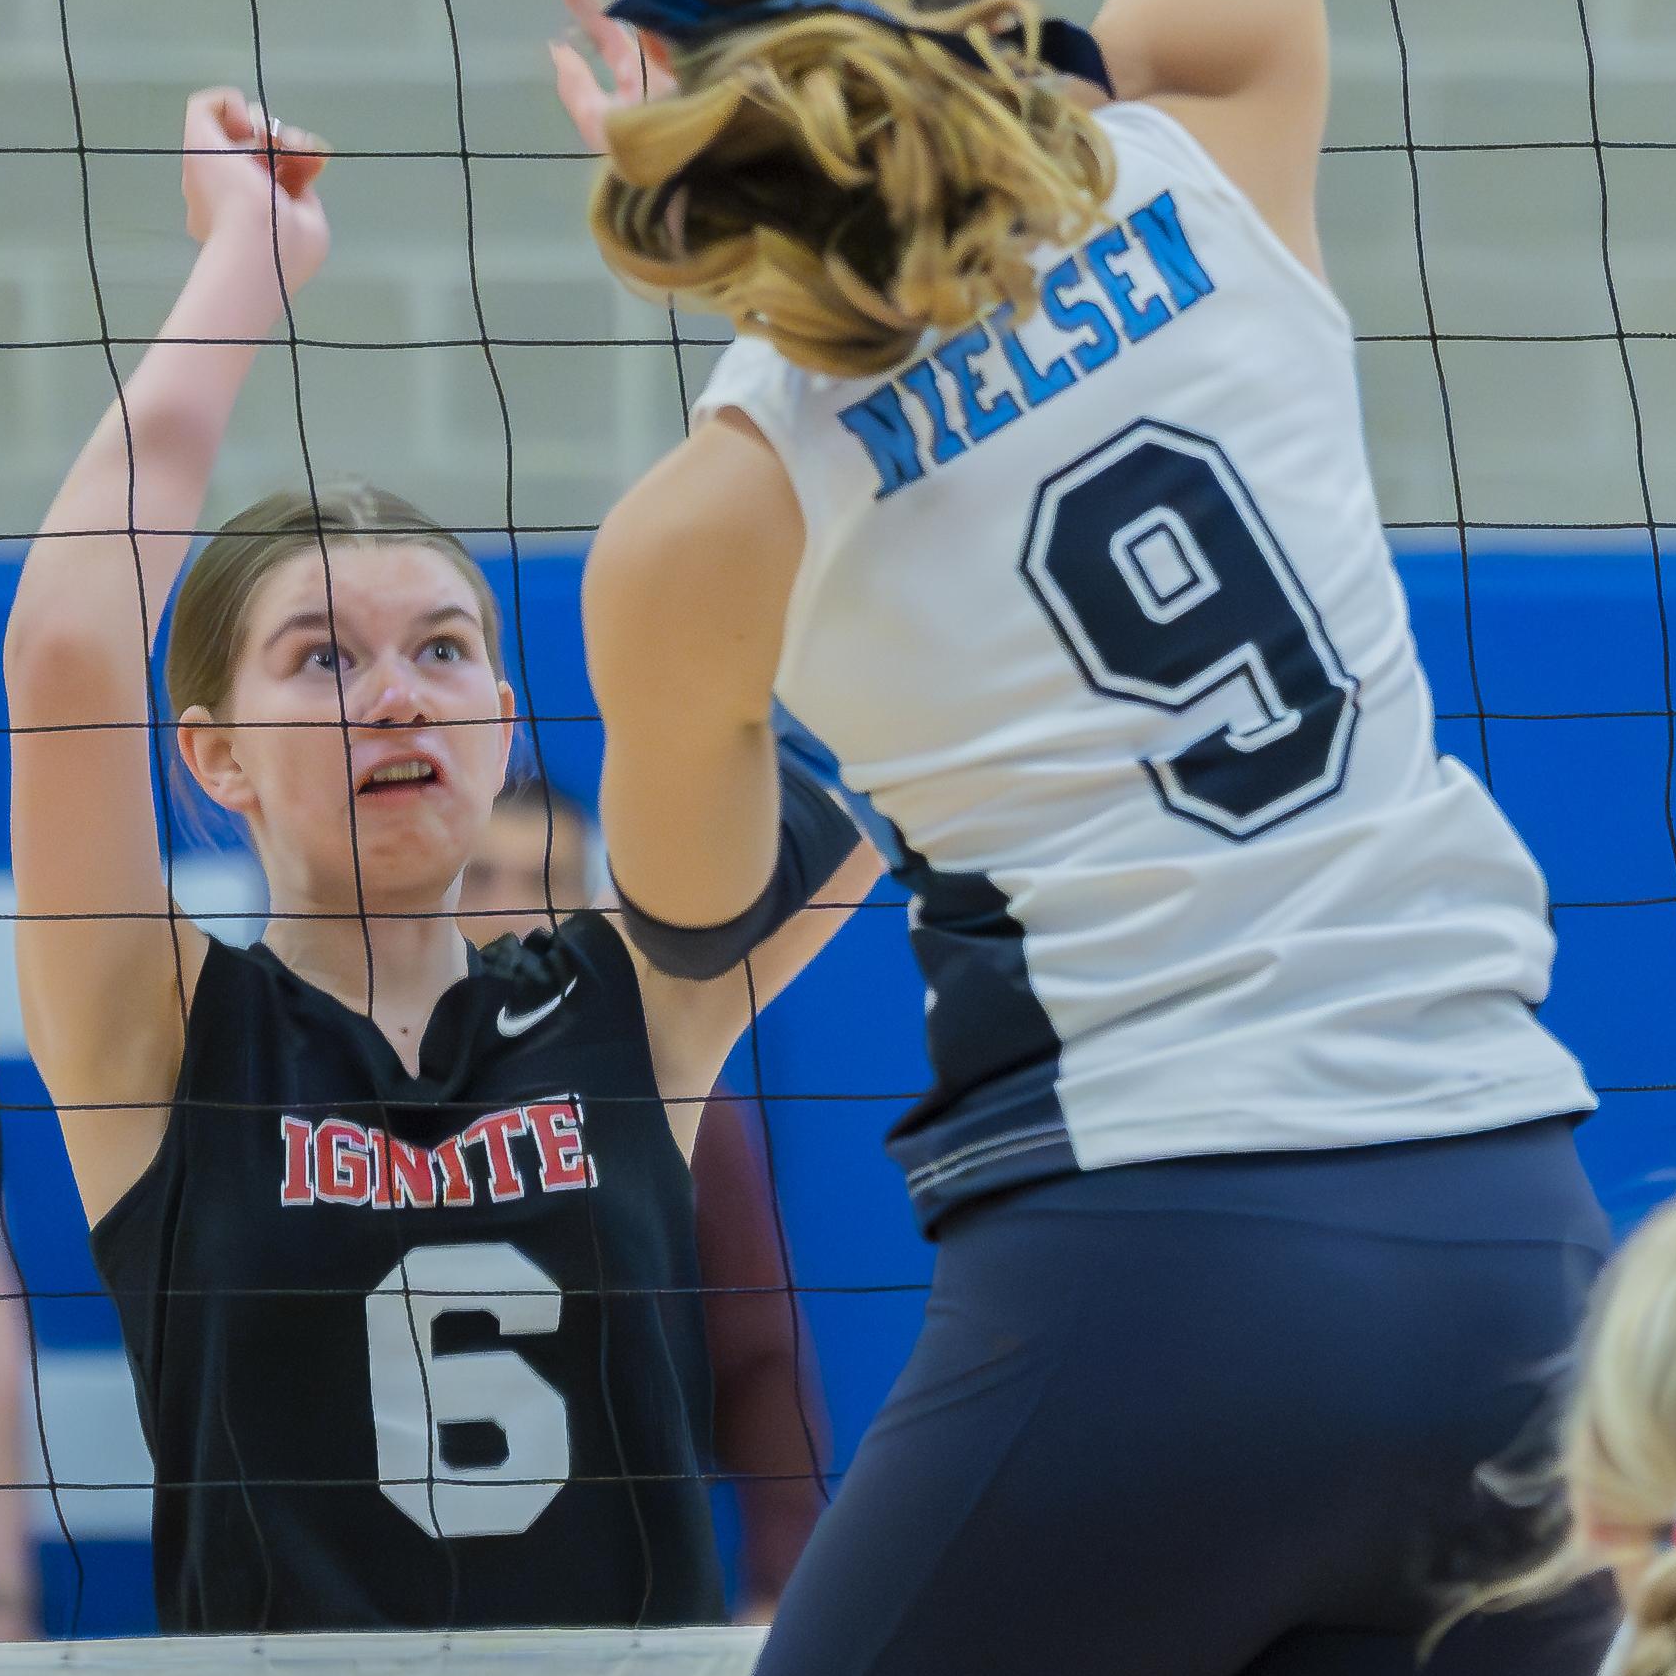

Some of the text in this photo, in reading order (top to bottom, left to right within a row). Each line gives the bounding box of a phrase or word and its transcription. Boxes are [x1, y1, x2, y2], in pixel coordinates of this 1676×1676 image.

[837, 190, 1215, 499] NIELSEN
[1019, 417, 1361, 843] 9
[280, 1093, 597, 1209] IGNITE
[367, 1242, 570, 1538] 6
